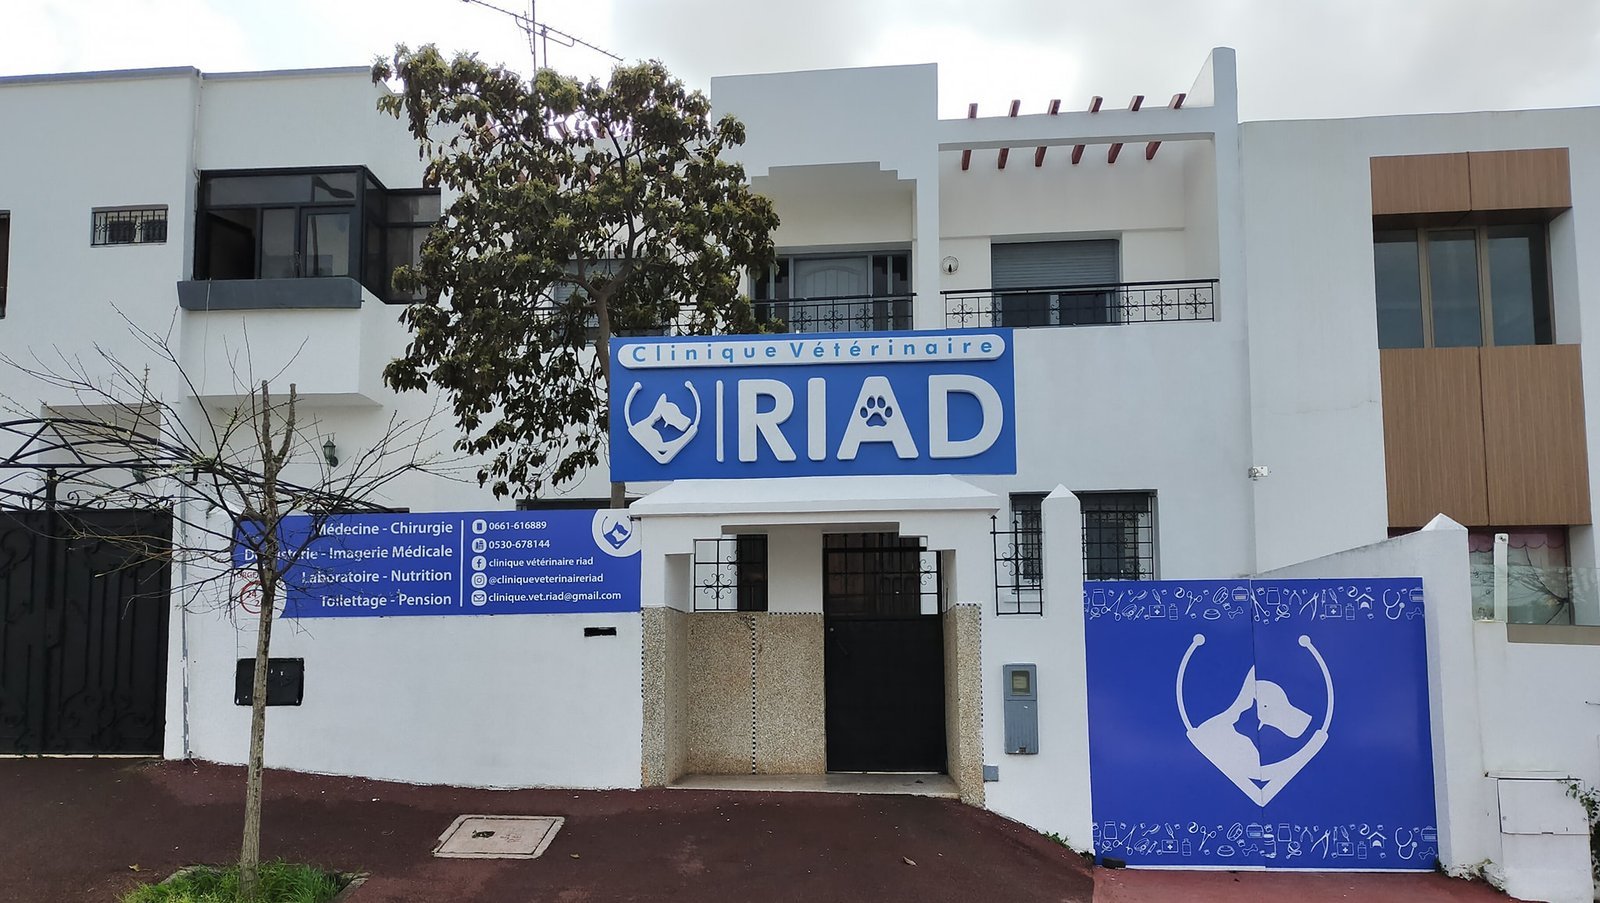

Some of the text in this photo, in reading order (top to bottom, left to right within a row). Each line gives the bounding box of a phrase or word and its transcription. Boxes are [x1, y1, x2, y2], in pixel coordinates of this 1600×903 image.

[632, 338, 994, 363] Clinique Vétérinaire
[738, 374, 1004, 463] RIAD
[316, 522, 379, 536] Médecine
[390, 521, 453, 537] Chirurgie
[488, 521, 547, 531] 0661-616889
[488, 539, 550, 549] 0530-678144
[329, 548, 388, 562] Imagerie
[391, 544, 453, 558] Médicale
[488, 557, 593, 568] clinique vétérinaire riad
[301, 571, 380, 584] Laboratoire
[391, 569, 452, 582] Nutrition
[488, 573, 604, 586] @cliniqueveterinaireriad
[319, 595, 387, 610] Toilettage
[398, 593, 452, 606] Pension
[488, 591, 622, 603] clinique.vet.riad@gmail.com
